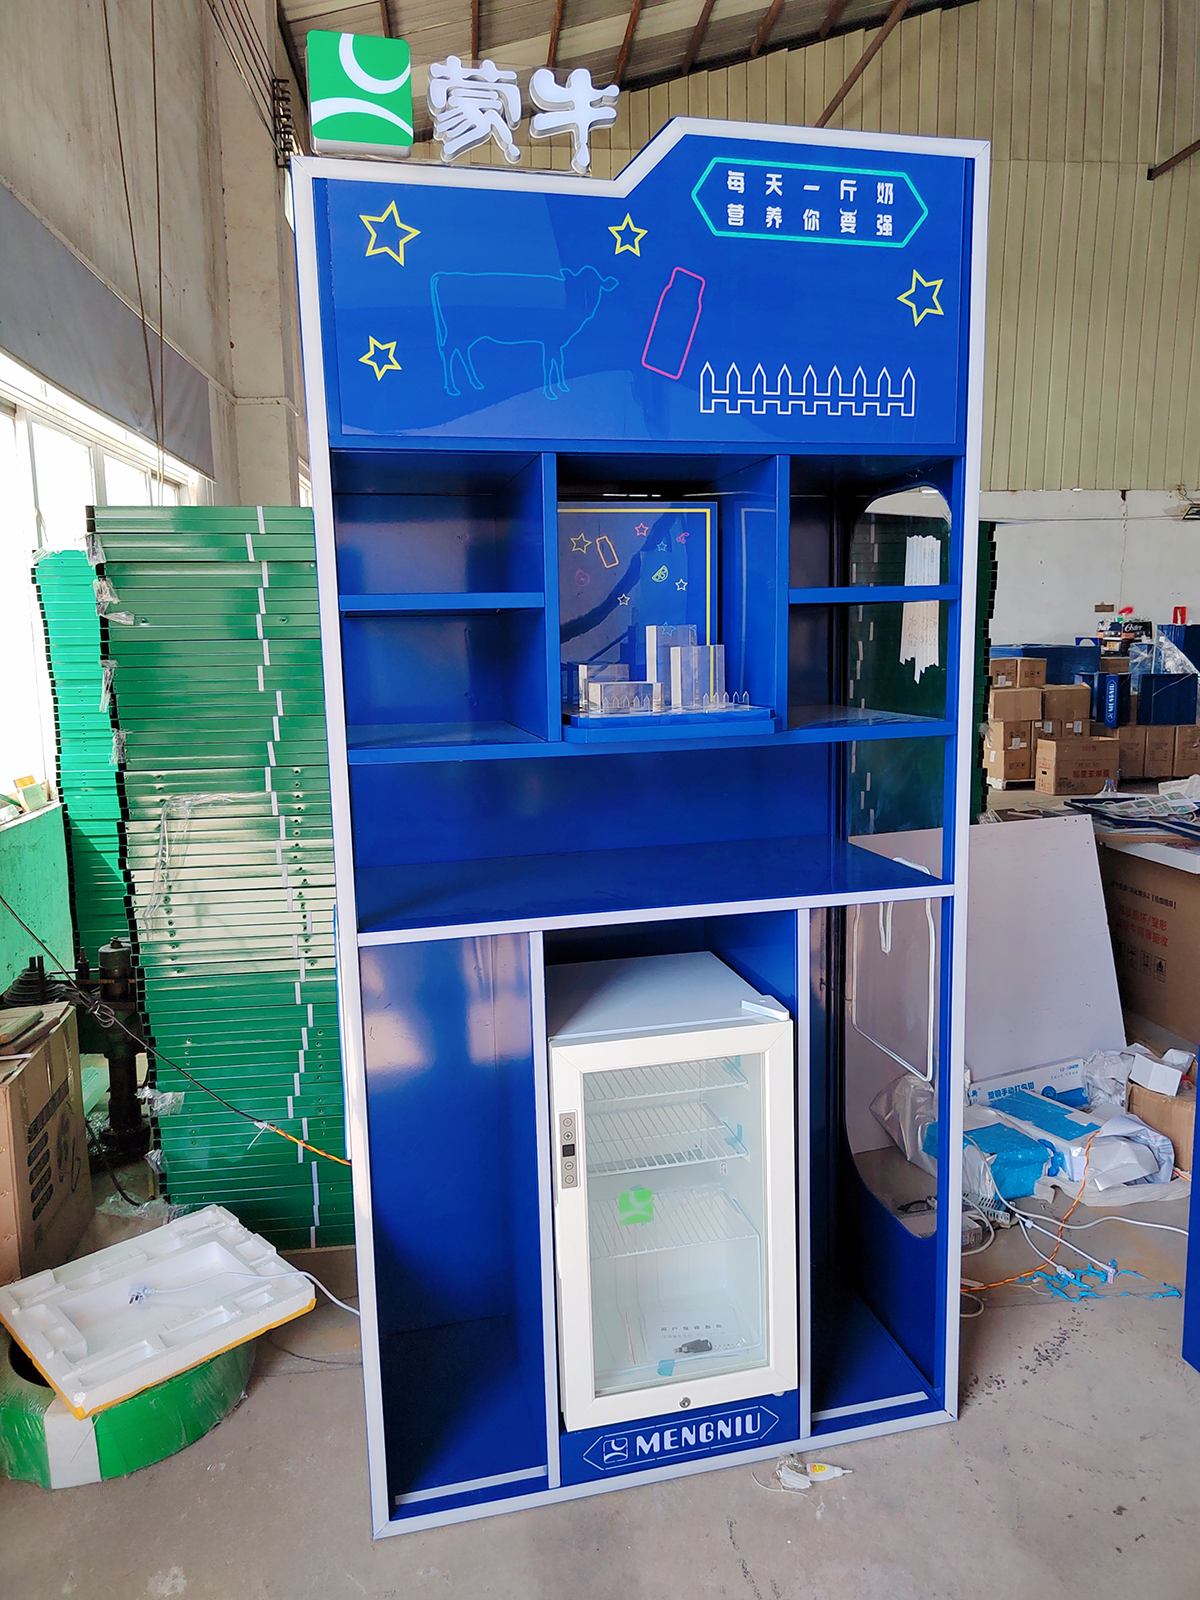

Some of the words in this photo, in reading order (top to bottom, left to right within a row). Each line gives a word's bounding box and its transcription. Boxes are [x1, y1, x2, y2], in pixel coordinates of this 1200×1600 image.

[427, 55, 620, 174] 蒙牛
[726, 170, 894, 205] 每天一斤奶
[726, 203, 893, 236] 营养你要强
[636, 1412, 761, 1457] MENGNIU
